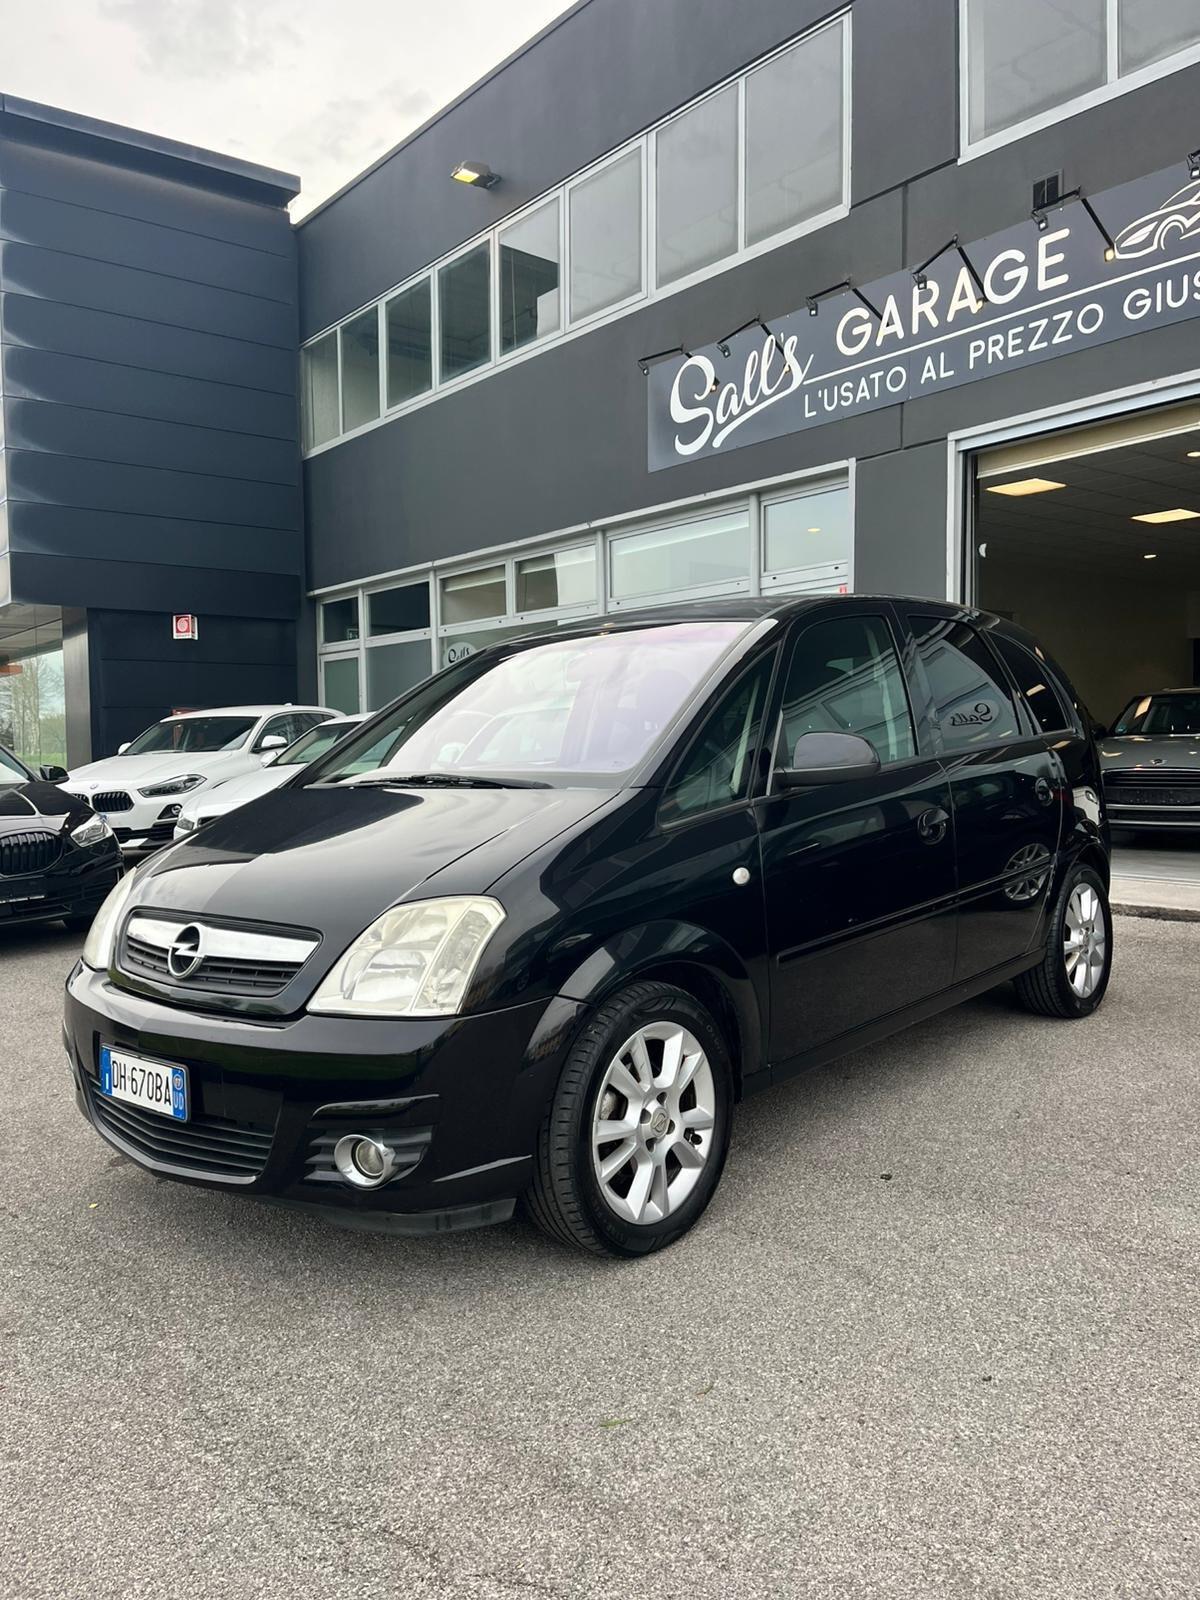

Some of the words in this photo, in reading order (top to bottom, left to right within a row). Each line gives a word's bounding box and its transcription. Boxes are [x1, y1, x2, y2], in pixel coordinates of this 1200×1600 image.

[670, 332, 814, 456] Sall's
[836, 228, 1070, 356] GARAGE
[804, 366, 907, 418] L'USATO
[920, 352, 955, 384] AL
[968, 303, 1104, 370] PREZZO
